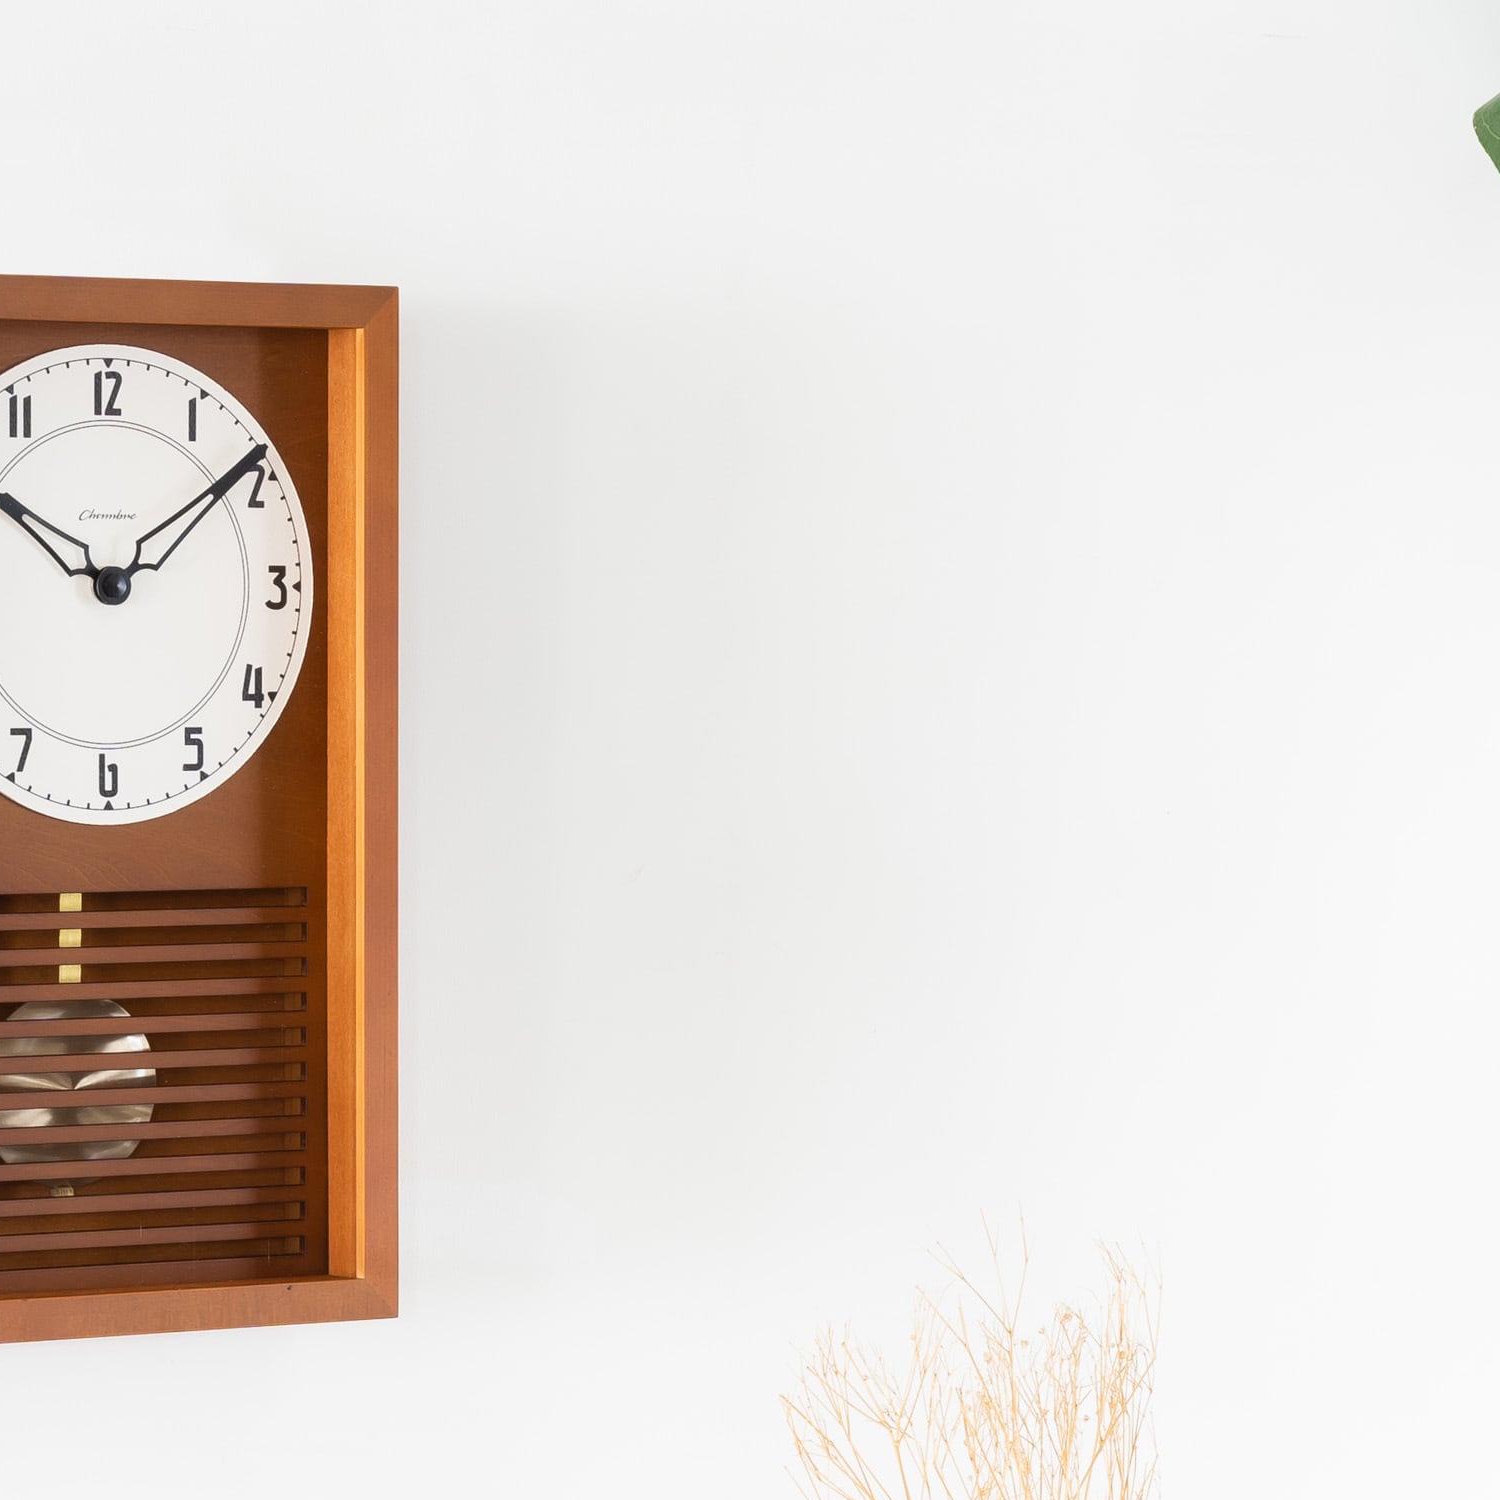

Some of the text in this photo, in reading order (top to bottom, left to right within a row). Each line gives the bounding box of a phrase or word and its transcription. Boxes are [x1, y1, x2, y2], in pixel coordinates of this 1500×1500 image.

[9, 394, 32, 438] 11
[94, 370, 123, 417] 12
[188, 397, 197, 442] 1
[247, 464, 266, 509] 2
[265, 565, 288, 611] 3
[242, 663, 265, 709] 4
[10, 727, 33, 773] 7
[182, 726, 204, 772] 5
[98, 753, 119, 799] 6
